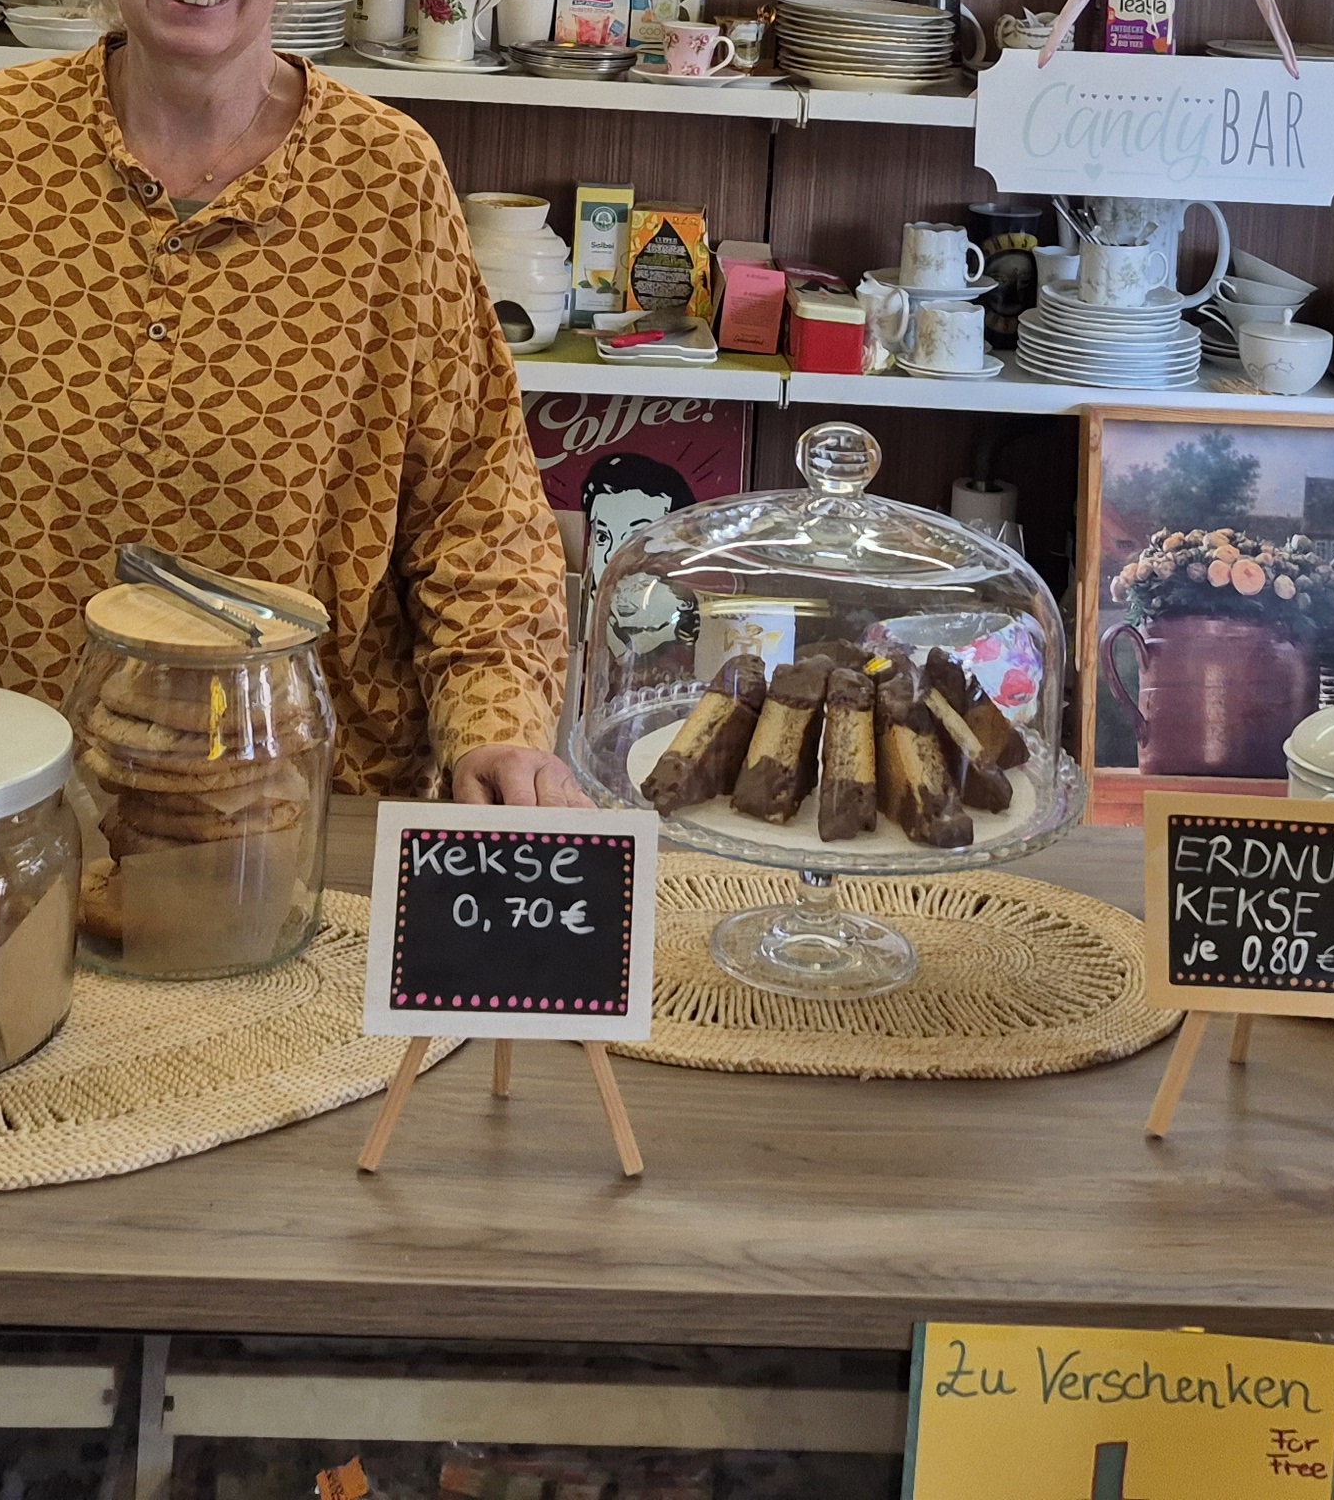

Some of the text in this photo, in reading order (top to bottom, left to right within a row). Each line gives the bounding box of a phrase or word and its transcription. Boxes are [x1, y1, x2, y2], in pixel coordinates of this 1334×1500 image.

[1110, 33, 1118, 47] 3
[1022, 81, 1306, 182] Candy BAR
[1175, 883, 1320, 937] KEKSE
[1183, 933, 1218, 966] je
[936, 1340, 1322, 1414] Zu Verschenken
[1271, 1428, 1319, 1453] For
[1267, 1454, 1328, 1480] Free
